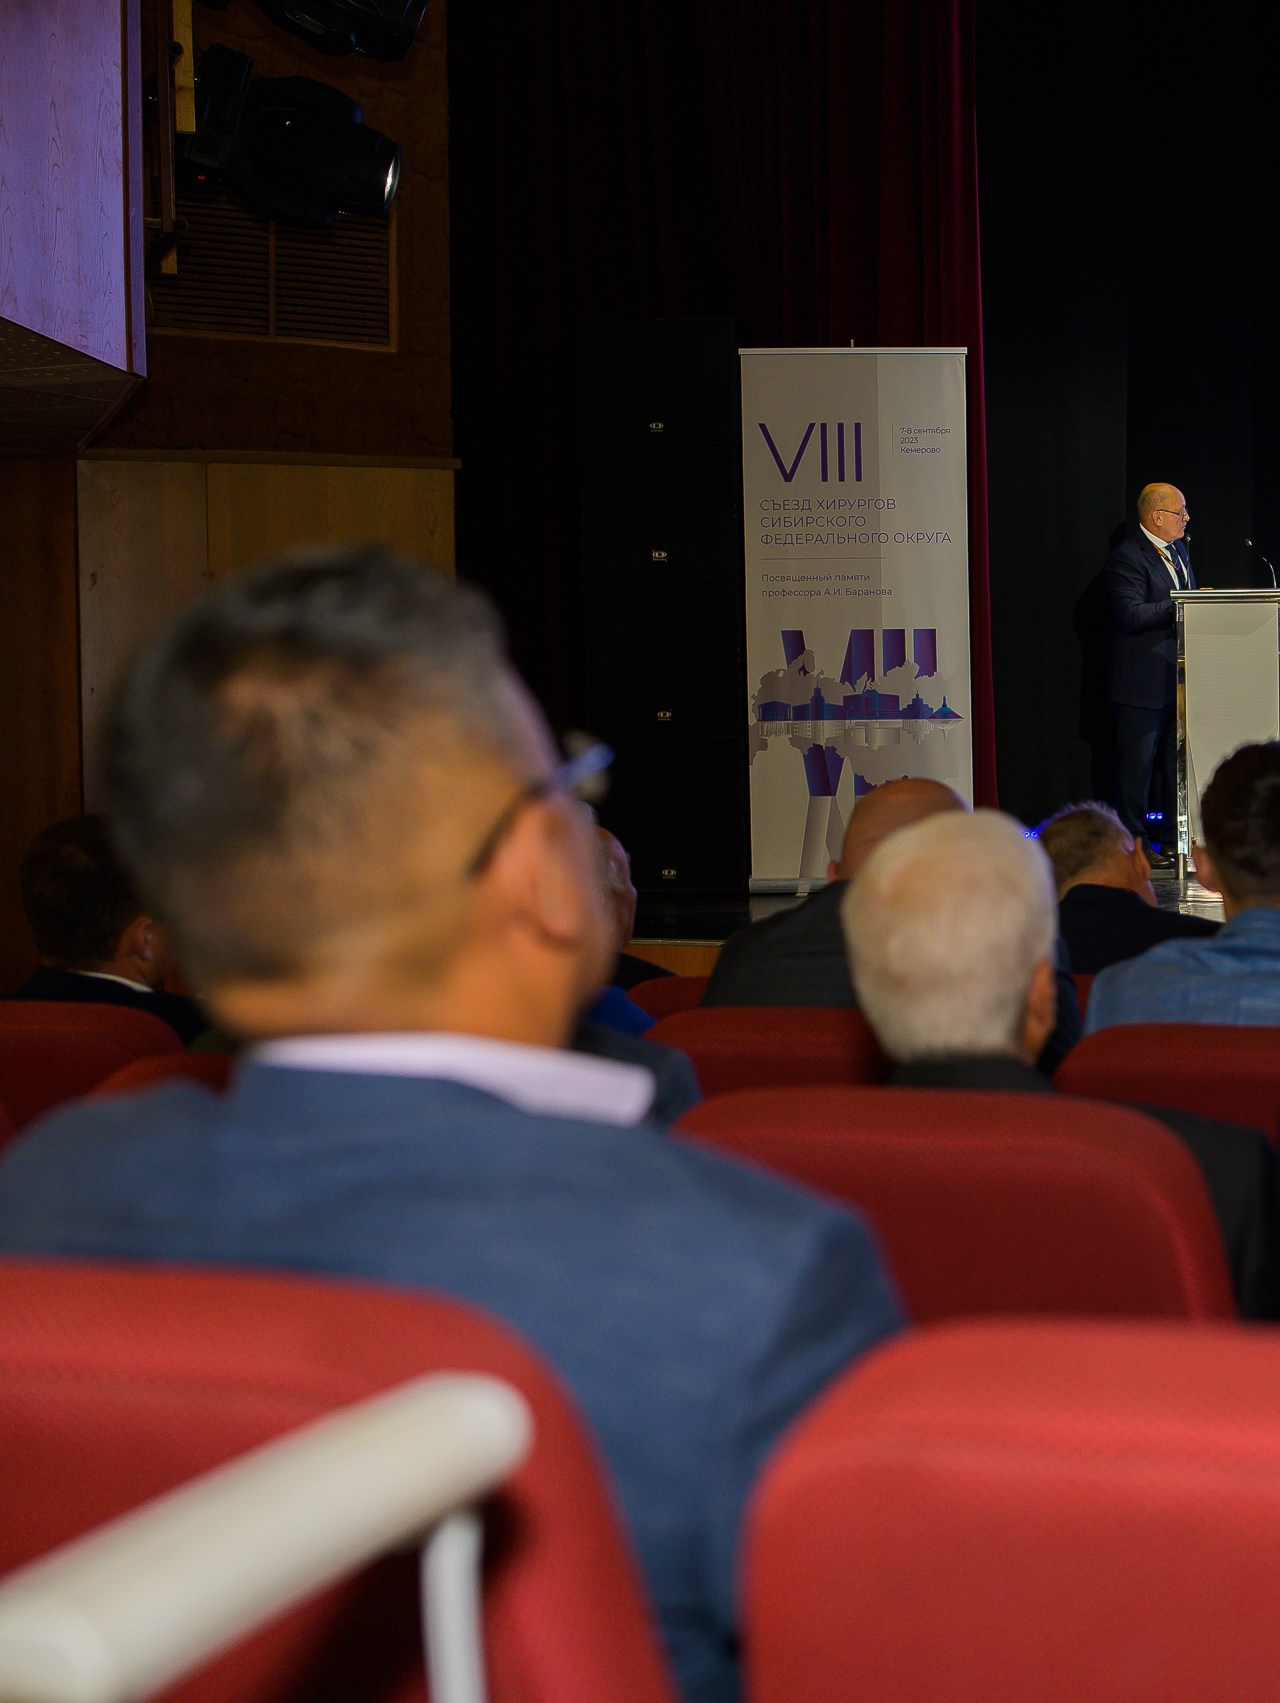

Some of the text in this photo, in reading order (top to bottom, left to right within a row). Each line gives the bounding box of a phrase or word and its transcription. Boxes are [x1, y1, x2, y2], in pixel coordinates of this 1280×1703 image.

[913, 427, 951, 435] сентября
[757, 422, 863, 483] VIII
[900, 447, 941, 455] Кемерово
[759, 498, 897, 513] СЪЕЗД ХИРУРГОВ
[760, 515, 866, 528] СИБИРСКОГО
[760, 531, 952, 547] ФЕДЕРАЛЬНОГО ОКРУГА
[761, 572, 870, 585] Посвященный памяти
[761, 587, 893, 598] профессора А.И. Баранова
